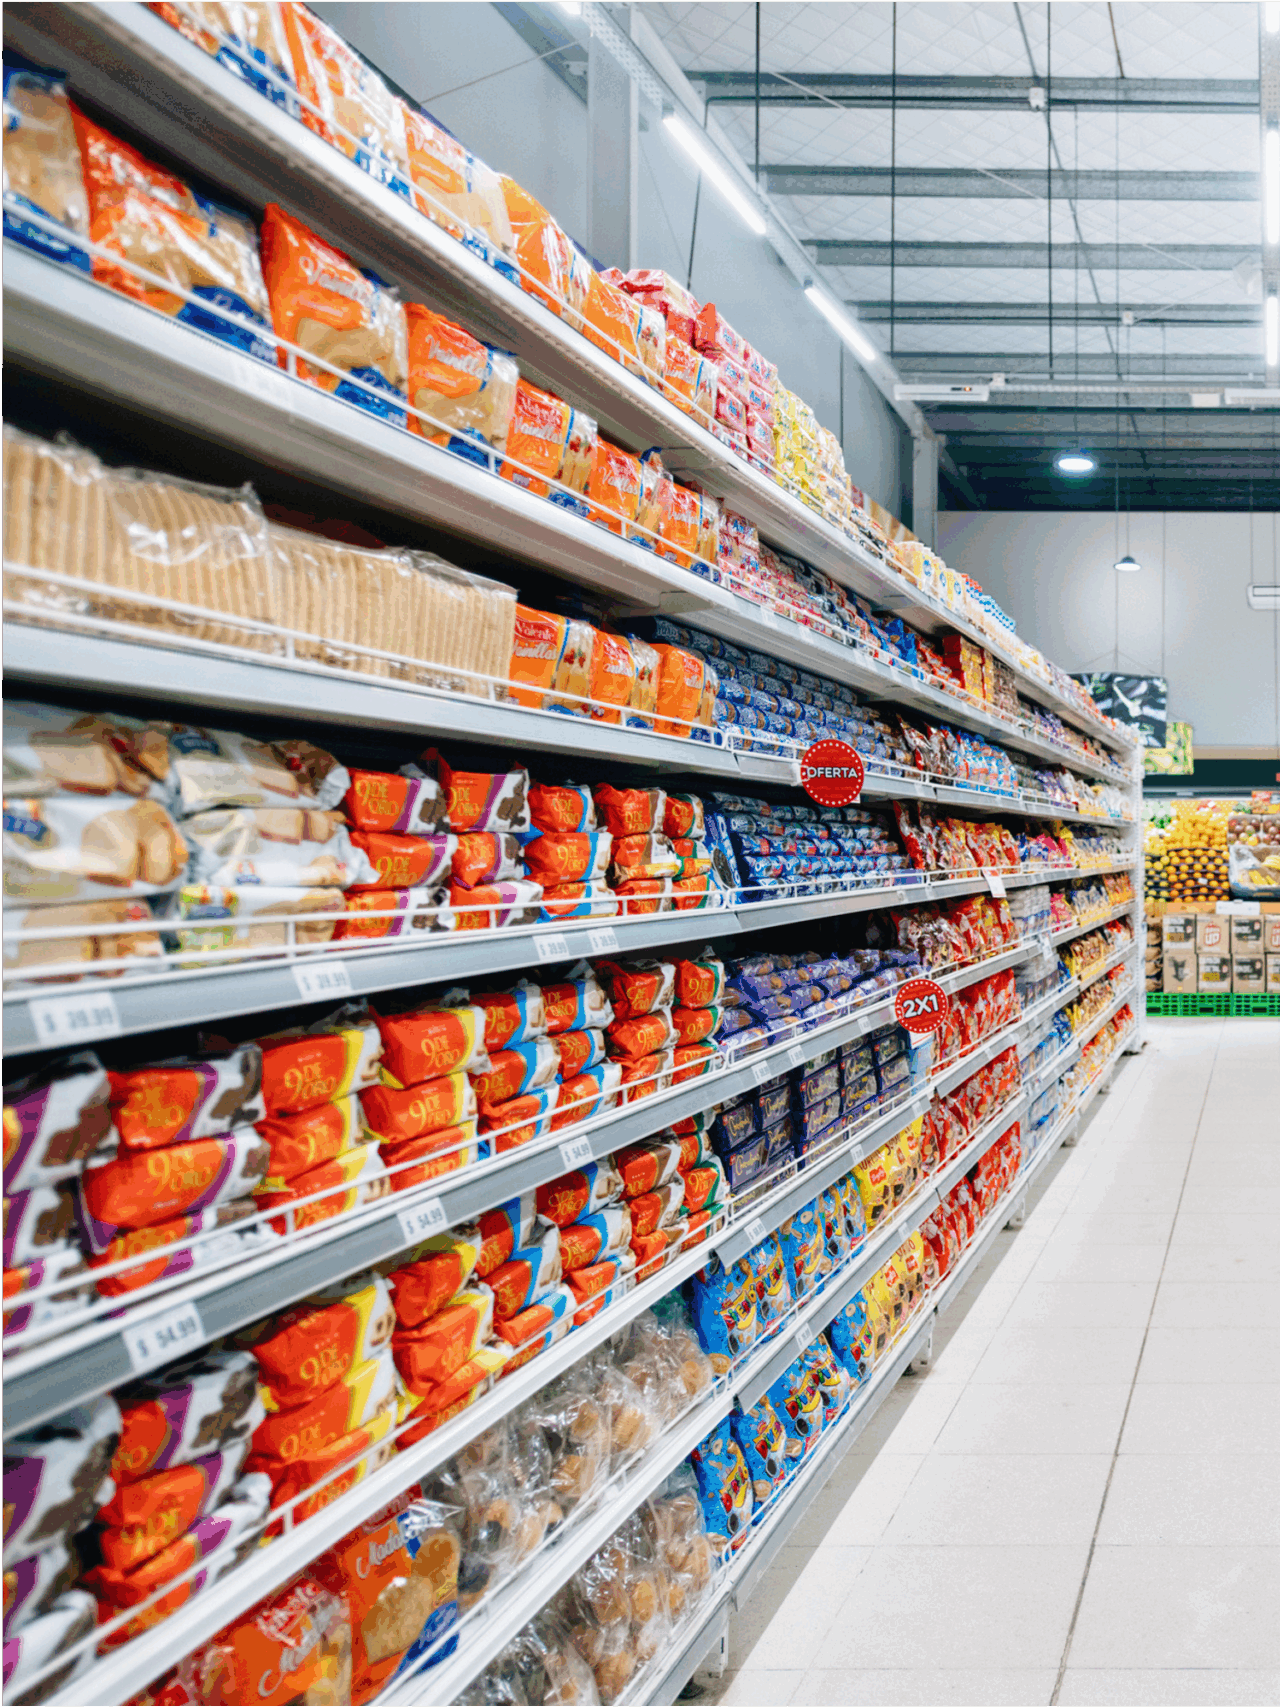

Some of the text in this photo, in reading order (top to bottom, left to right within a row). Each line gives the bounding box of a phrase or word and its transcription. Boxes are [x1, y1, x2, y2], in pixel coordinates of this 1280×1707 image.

[806, 766, 858, 779] OFERTA
[556, 845, 569, 877] 9
[902, 993, 939, 1019] 2X1
[409, 1099, 427, 1133] 9
[564, 1142, 590, 1163] $ 54.99
[406, 1207, 443, 1235] $ 54.99
[136, 1318, 198, 1359] $ 54.99
